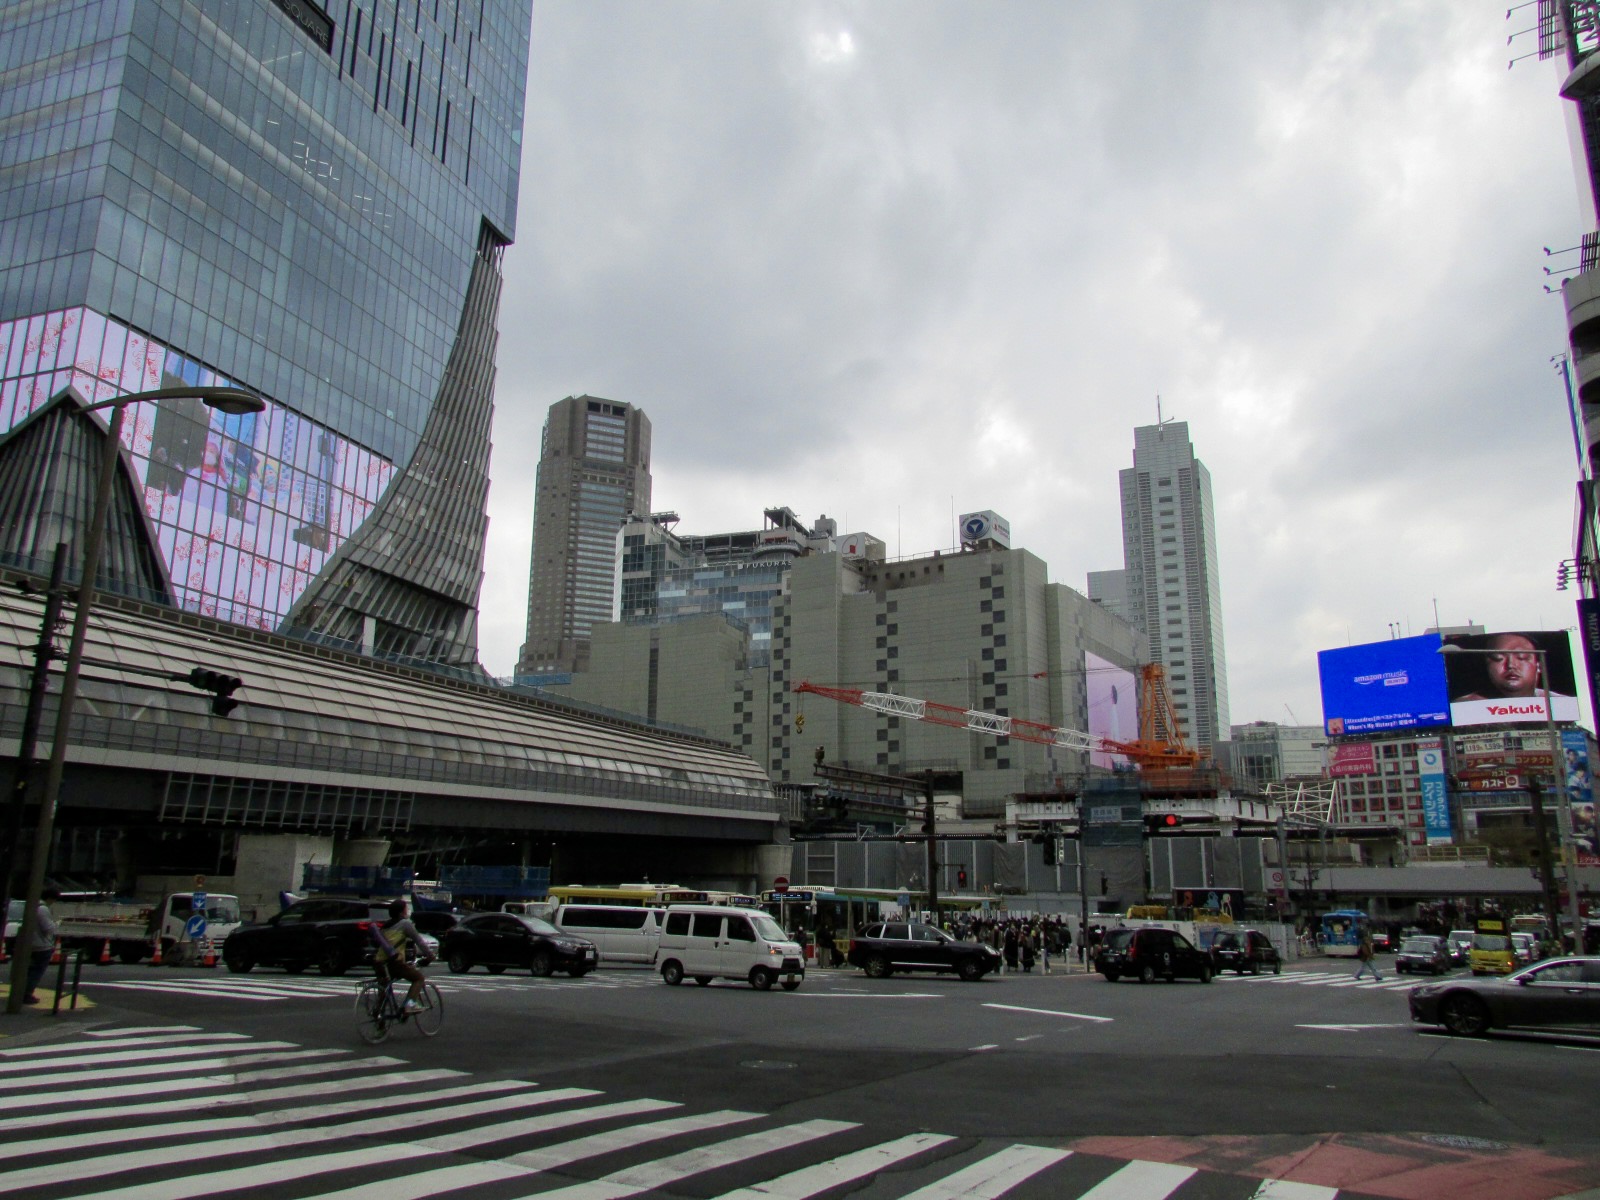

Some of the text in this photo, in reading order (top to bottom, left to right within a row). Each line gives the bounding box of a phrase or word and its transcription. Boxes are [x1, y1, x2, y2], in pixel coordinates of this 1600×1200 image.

[1588, 613, 1600, 651] MIZUHO
[1354, 674, 1382, 683] amazon
[1383, 669, 1408, 679] music
[1487, 704, 1545, 715] Yakult
[1516, 755, 1552, 764] コンタクト
[1481, 778, 1504, 788] ガスト
